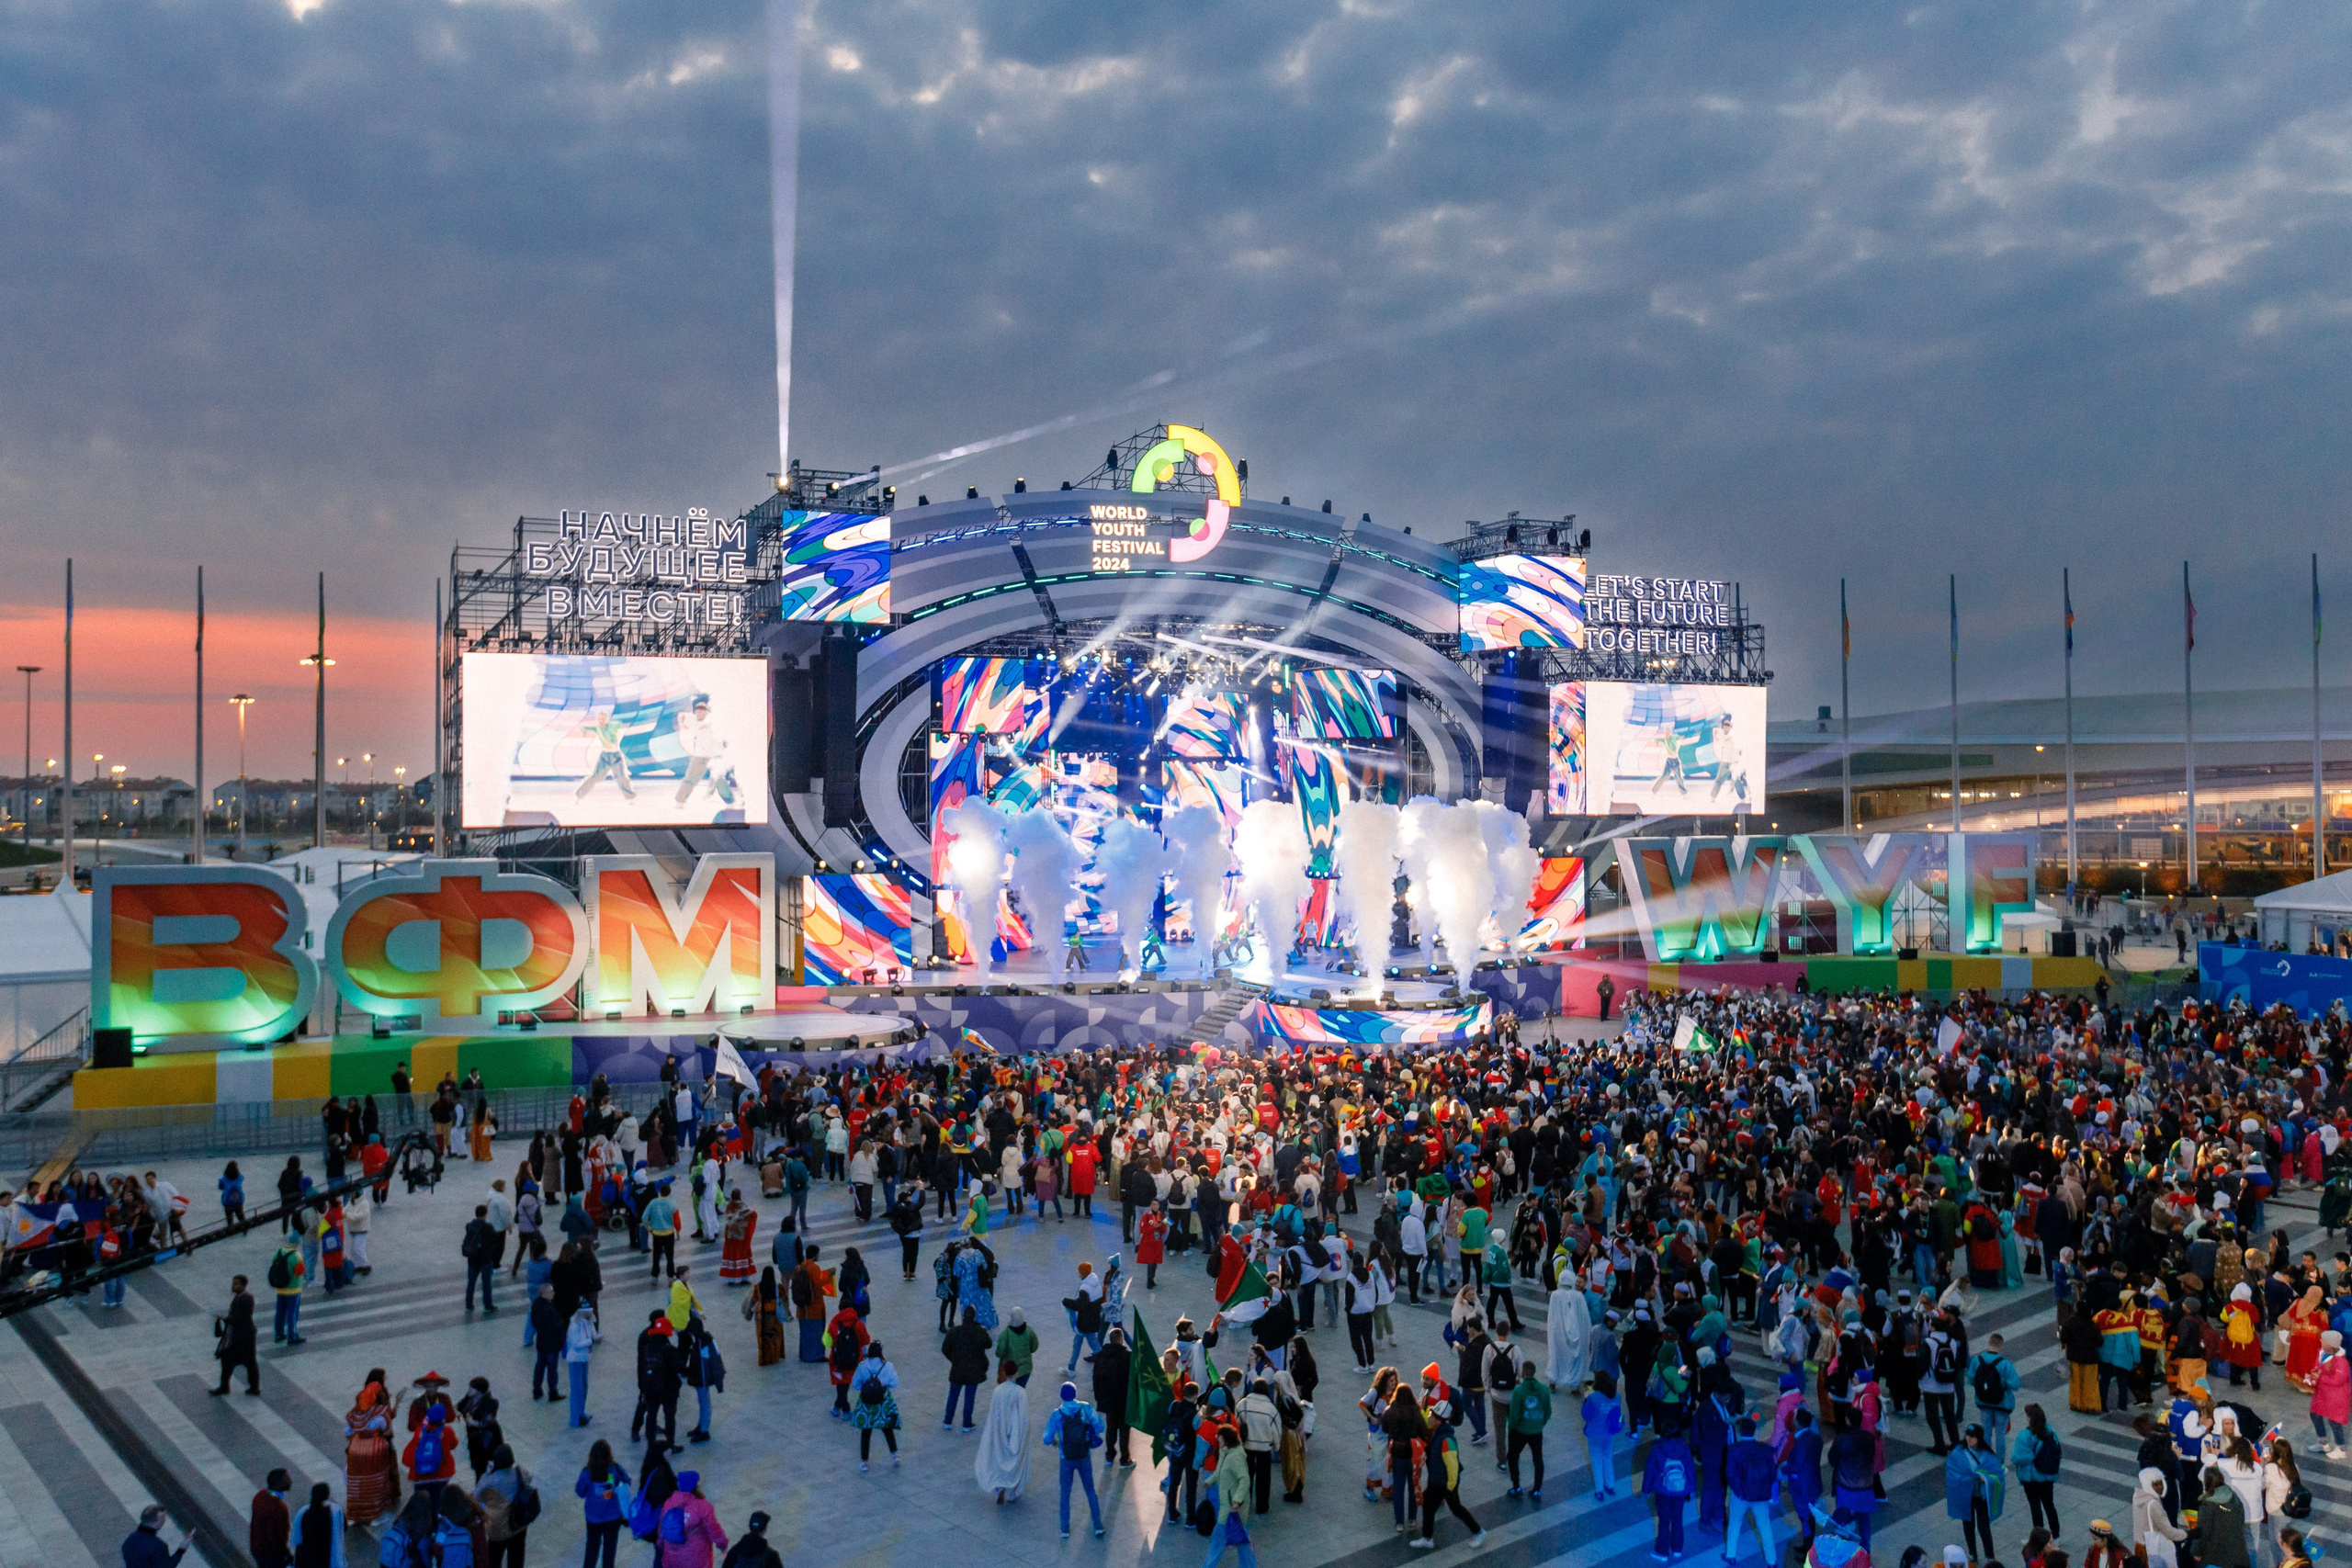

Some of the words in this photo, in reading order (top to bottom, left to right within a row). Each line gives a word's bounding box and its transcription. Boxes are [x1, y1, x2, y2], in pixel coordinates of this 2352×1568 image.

[1090, 505, 1148, 520] WORLD
[560, 507, 747, 550] НАЧНЁМ
[1091, 522, 1146, 537] YOUTH
[1092, 539, 1165, 555] FESTIVAL
[526, 541, 747, 588] БУДУЩЕЕ
[1092, 557, 1130, 570] 2024
[1653, 577, 1724, 604] START
[546, 585, 742, 626] ВМЕСТЕ!
[1584, 597, 1631, 624] THE
[1637, 600, 1729, 626] FUTURE
[1584, 627, 1717, 655] TOGETHER!
[1613, 832, 2036, 963] WYF
[92, 852, 775, 1053] ВФМ
